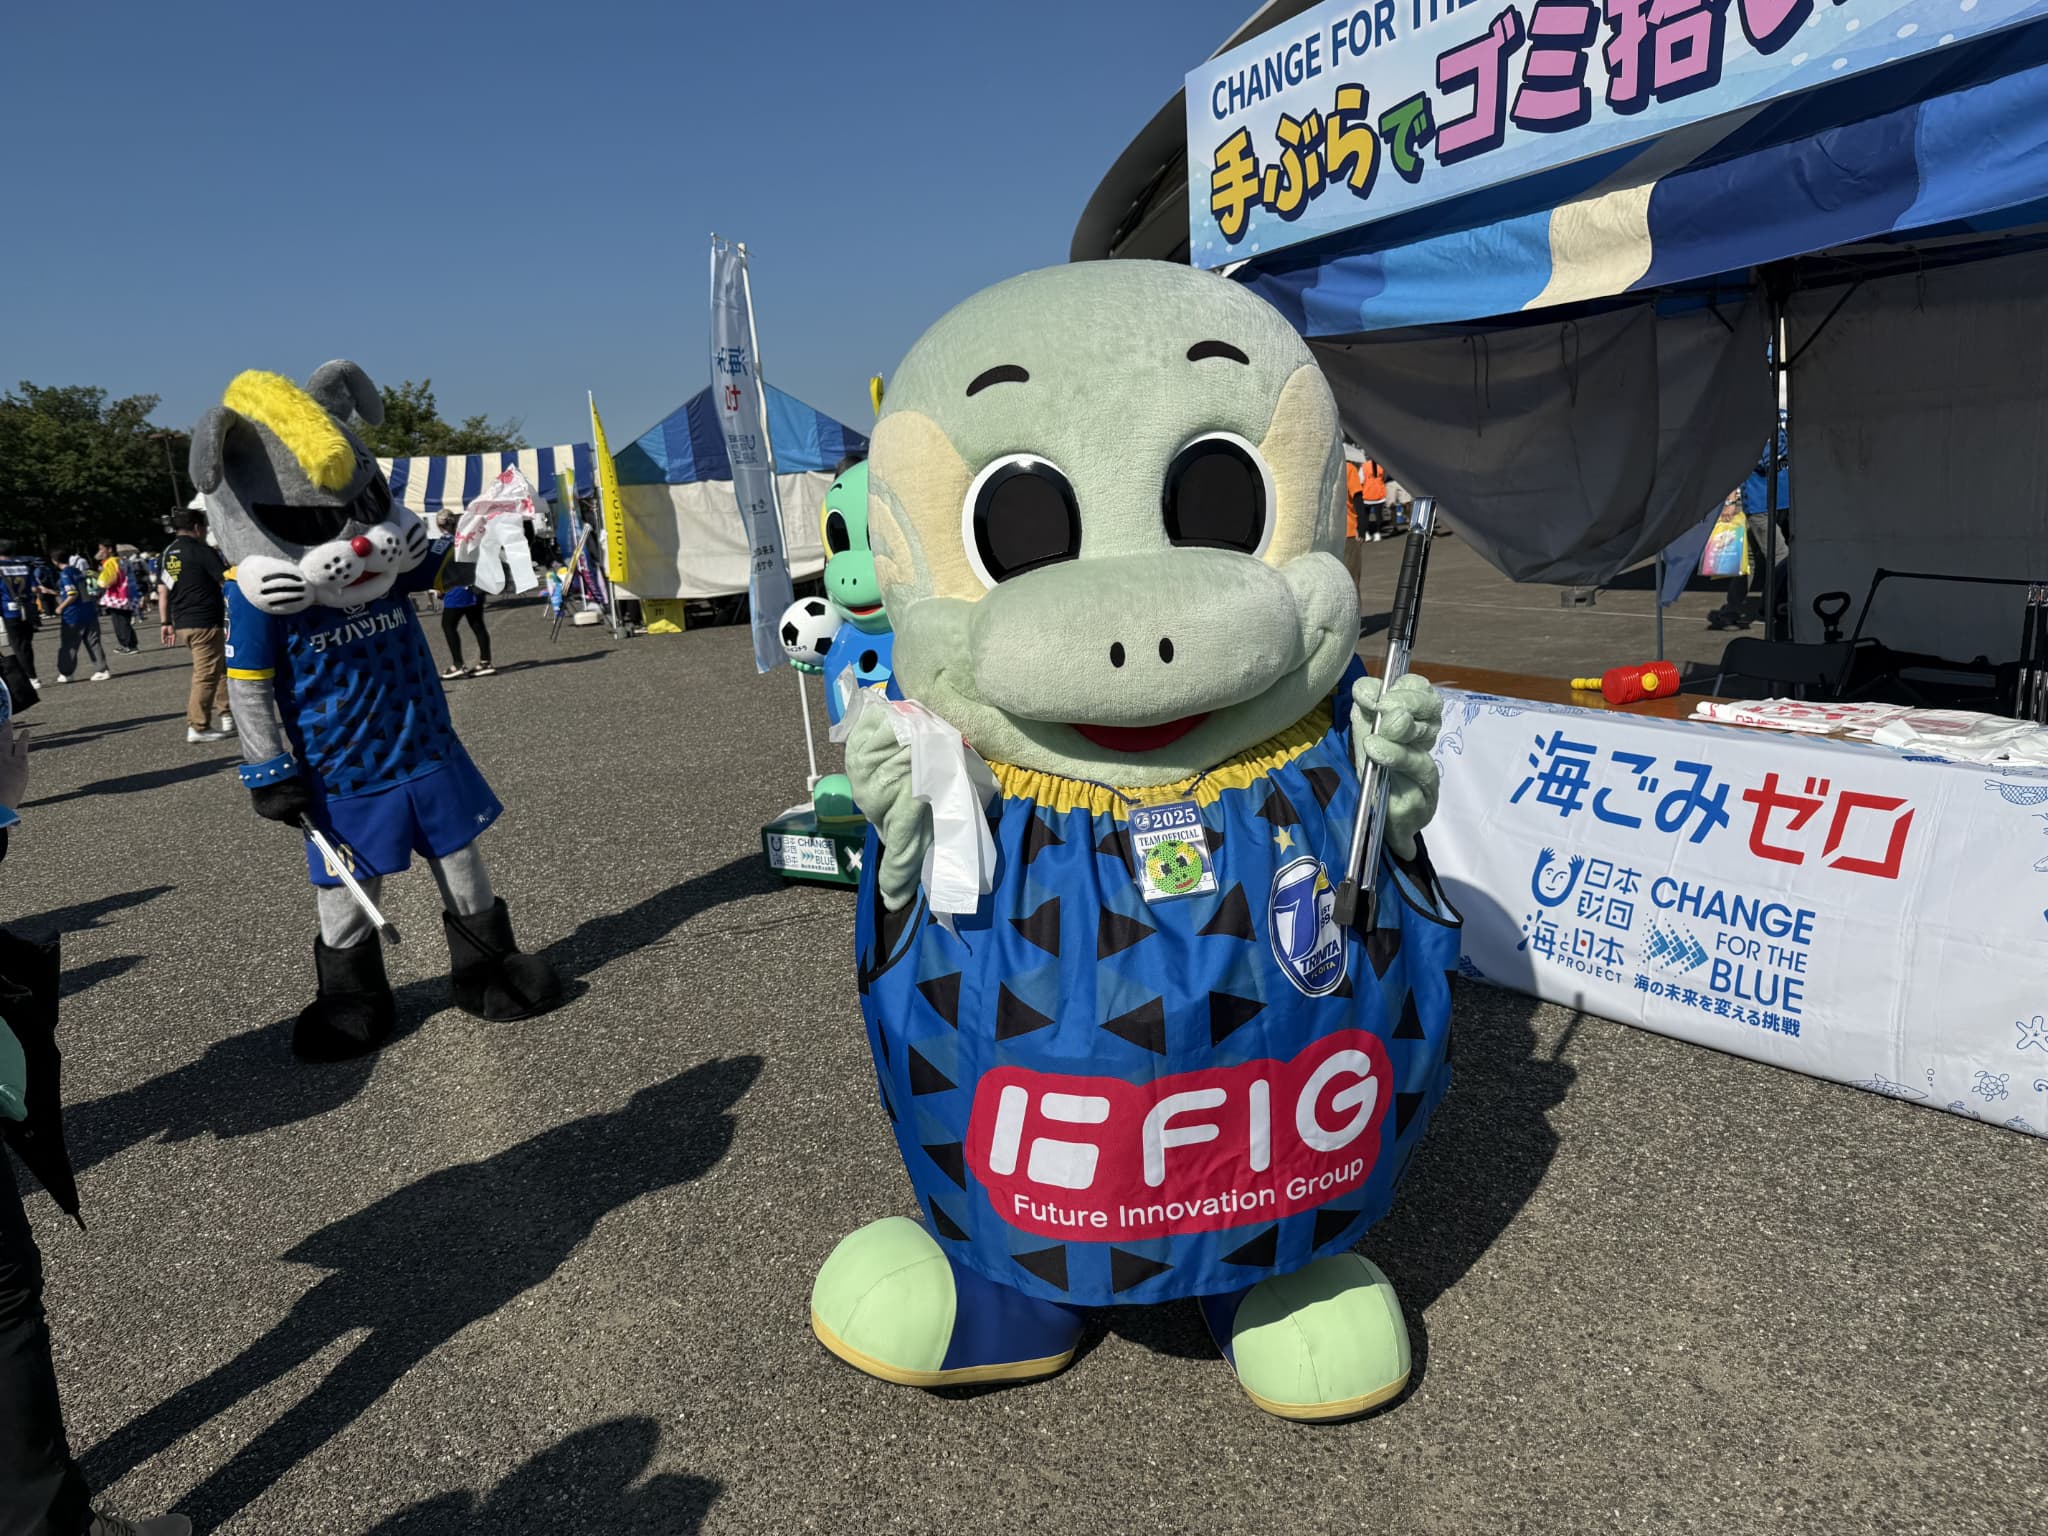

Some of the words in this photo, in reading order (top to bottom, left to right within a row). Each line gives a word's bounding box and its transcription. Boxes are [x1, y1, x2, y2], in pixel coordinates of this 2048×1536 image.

[1212, 32, 1322, 120] CHANGE
[1331, 0, 1397, 67] FOR
[309, 607, 408, 653] ダイハツ九州
[1151, 808, 1196, 829] 2025
[1510, 730, 1915, 880] 海ごみゼロ
[798, 838, 833, 849] CHANGE
[815, 855, 835, 866] BLUE
[1138, 834, 1161, 847] TEAM
[1162, 828, 1200, 843] OFFICIAL
[1584, 857, 1642, 895] 日本
[1577, 889, 1634, 931] 財団
[1651, 876, 1816, 945] CHANGE
[1517, 909, 1625, 967] 海と日本
[1716, 932, 1761, 961] FOR
[1767, 945, 1808, 973] THE
[1556, 954, 1623, 984] PROJECT
[1709, 957, 1804, 1014] BLUE
[1633, 973, 1801, 1038] 海の未来を変える挑戦
[1142, 1049, 1378, 1188] FIG
[1014, 1194, 1108, 1228] Future
[1119, 1188, 1276, 1228] Innovation
[1286, 1157, 1364, 1201] Group
